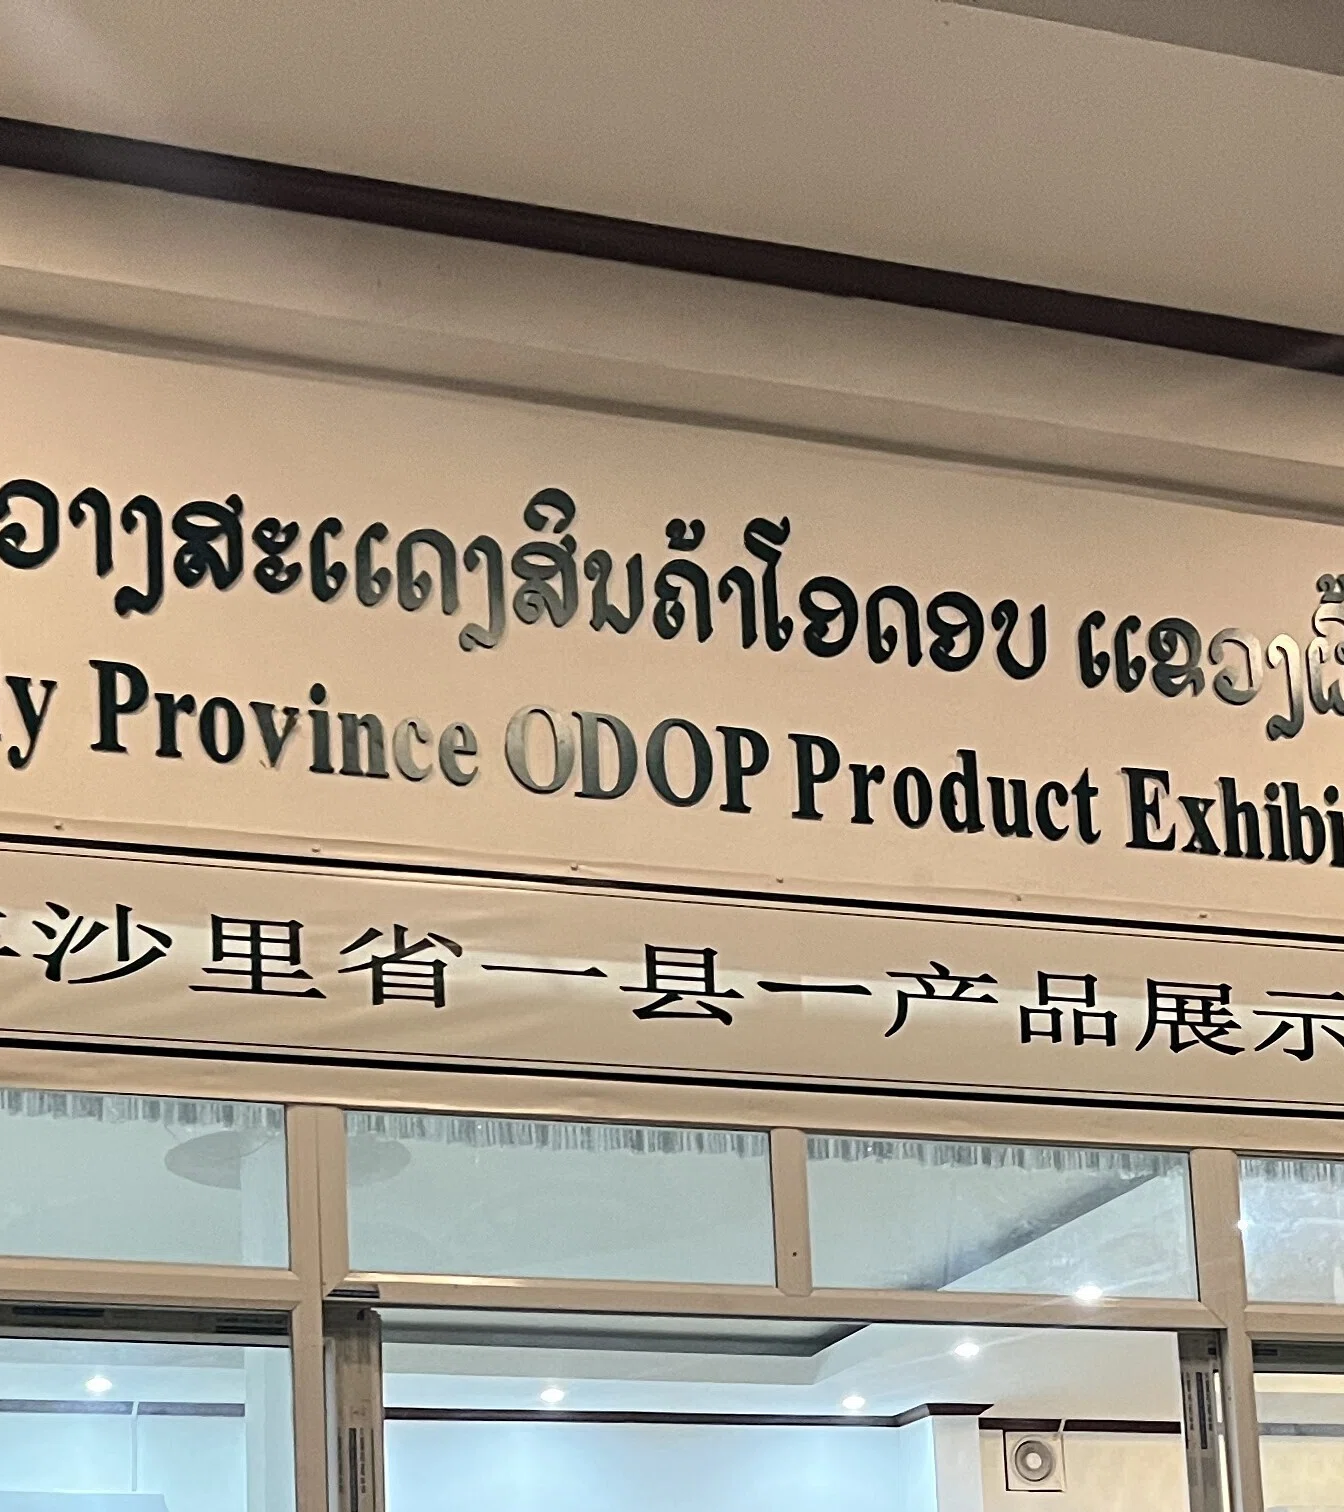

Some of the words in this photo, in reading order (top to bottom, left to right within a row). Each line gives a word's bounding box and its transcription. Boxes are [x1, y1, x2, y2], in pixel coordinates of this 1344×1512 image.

[88, 657, 479, 781] Province
[505, 704, 770, 814] ODOP
[788, 732, 1101, 846] Product
